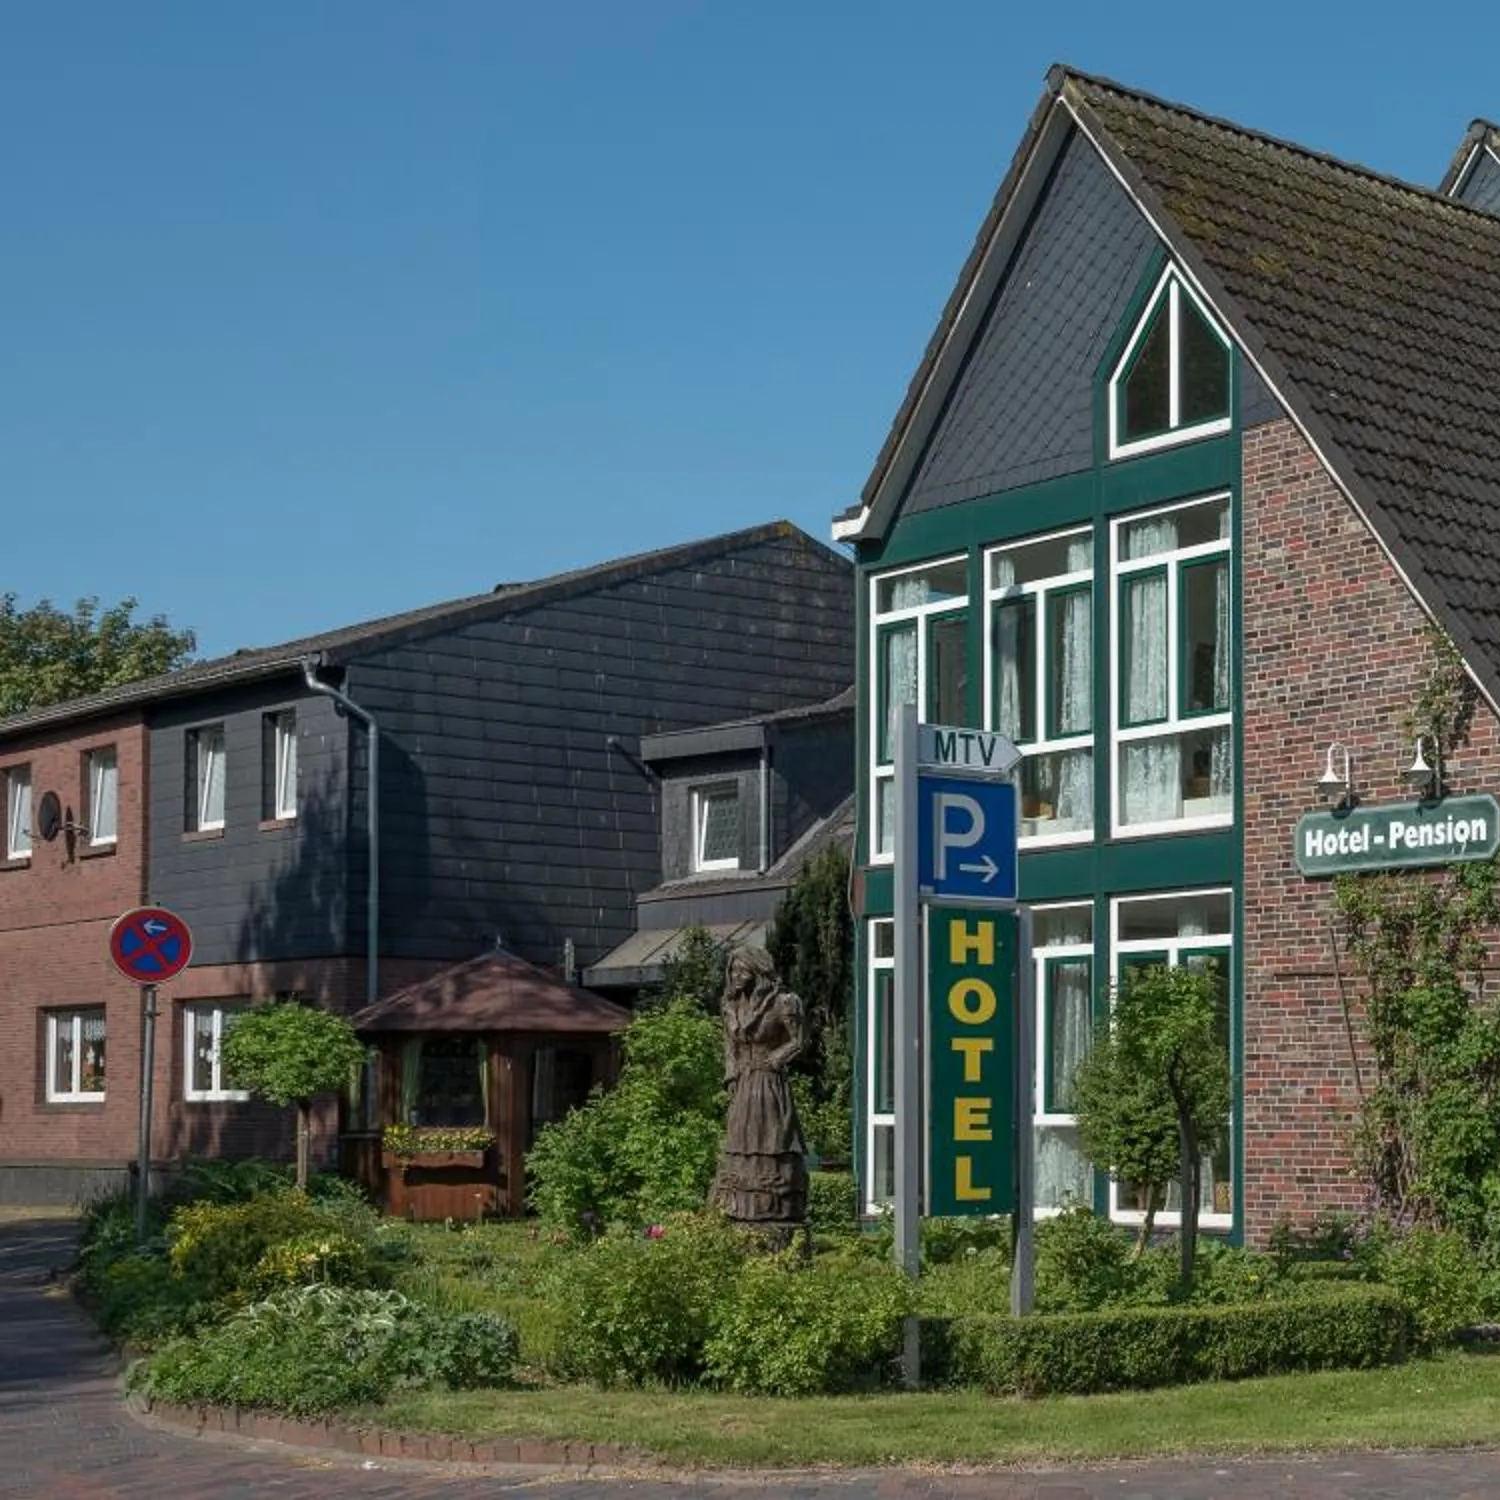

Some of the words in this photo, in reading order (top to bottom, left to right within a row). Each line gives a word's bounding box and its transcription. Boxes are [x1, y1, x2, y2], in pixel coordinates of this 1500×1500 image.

[934, 730, 996, 766] MTV
[933, 792, 985, 880] P
[948, 920, 996, 1200] HOTEL
